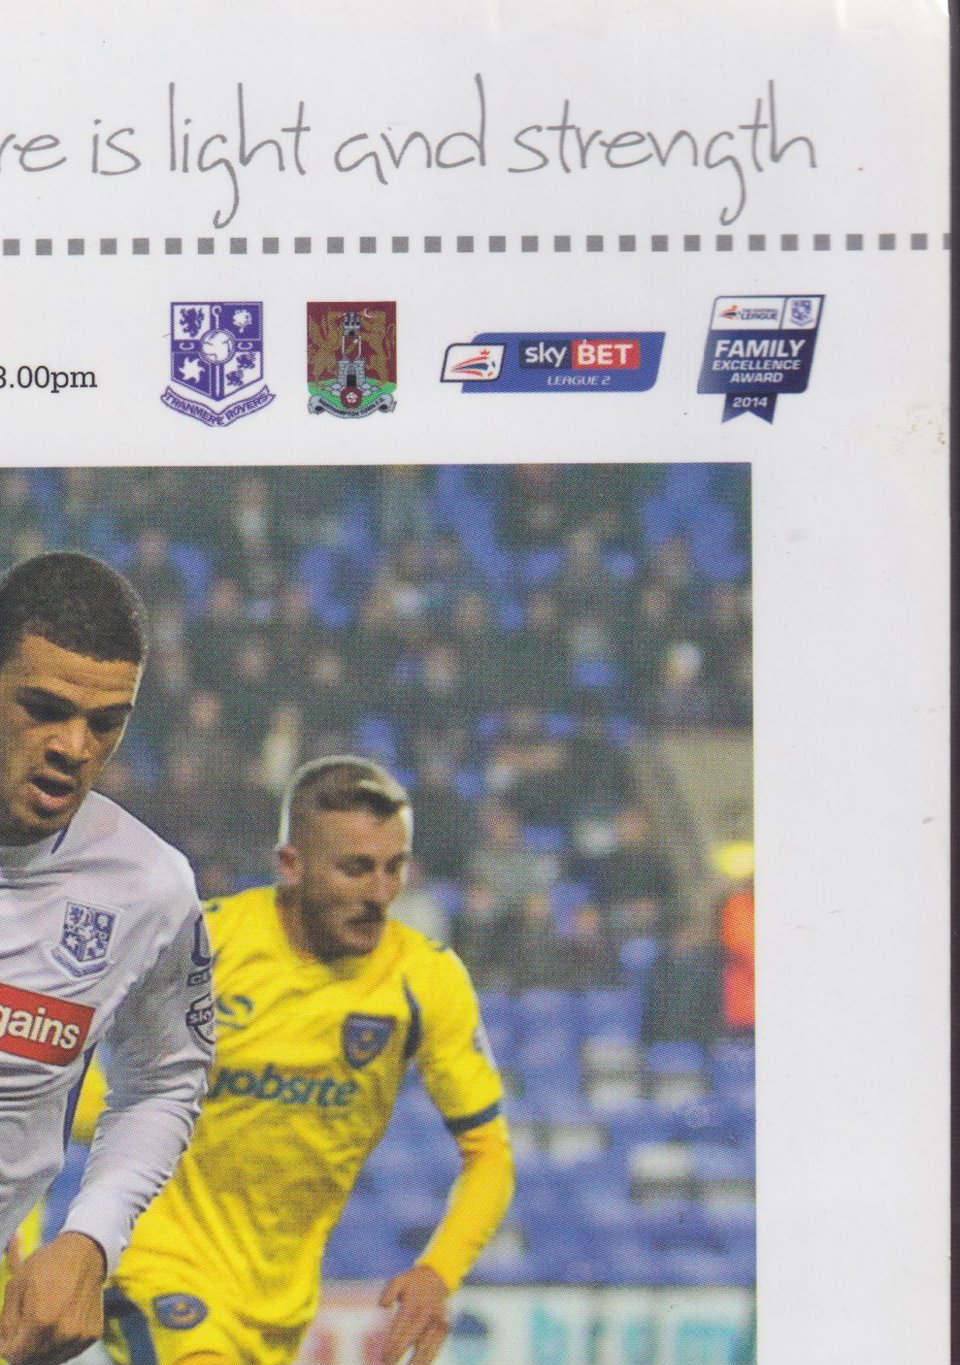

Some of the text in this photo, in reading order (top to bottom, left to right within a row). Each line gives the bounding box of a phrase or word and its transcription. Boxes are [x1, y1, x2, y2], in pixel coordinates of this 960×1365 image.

[93, 119, 142, 176] is
[169, 82, 311, 230] light
[335, 73, 488, 186] and
[508, 80, 818, 227] strength
[525, 341, 633, 367] sky BET
[714, 340, 806, 358] FAMILY
[712, 360, 800, 371] EXCELLENCE
[547, 375, 611, 385] LEAGUE 2
[729, 372, 784, 383] AWARD
[733, 397, 768, 408] 2014
